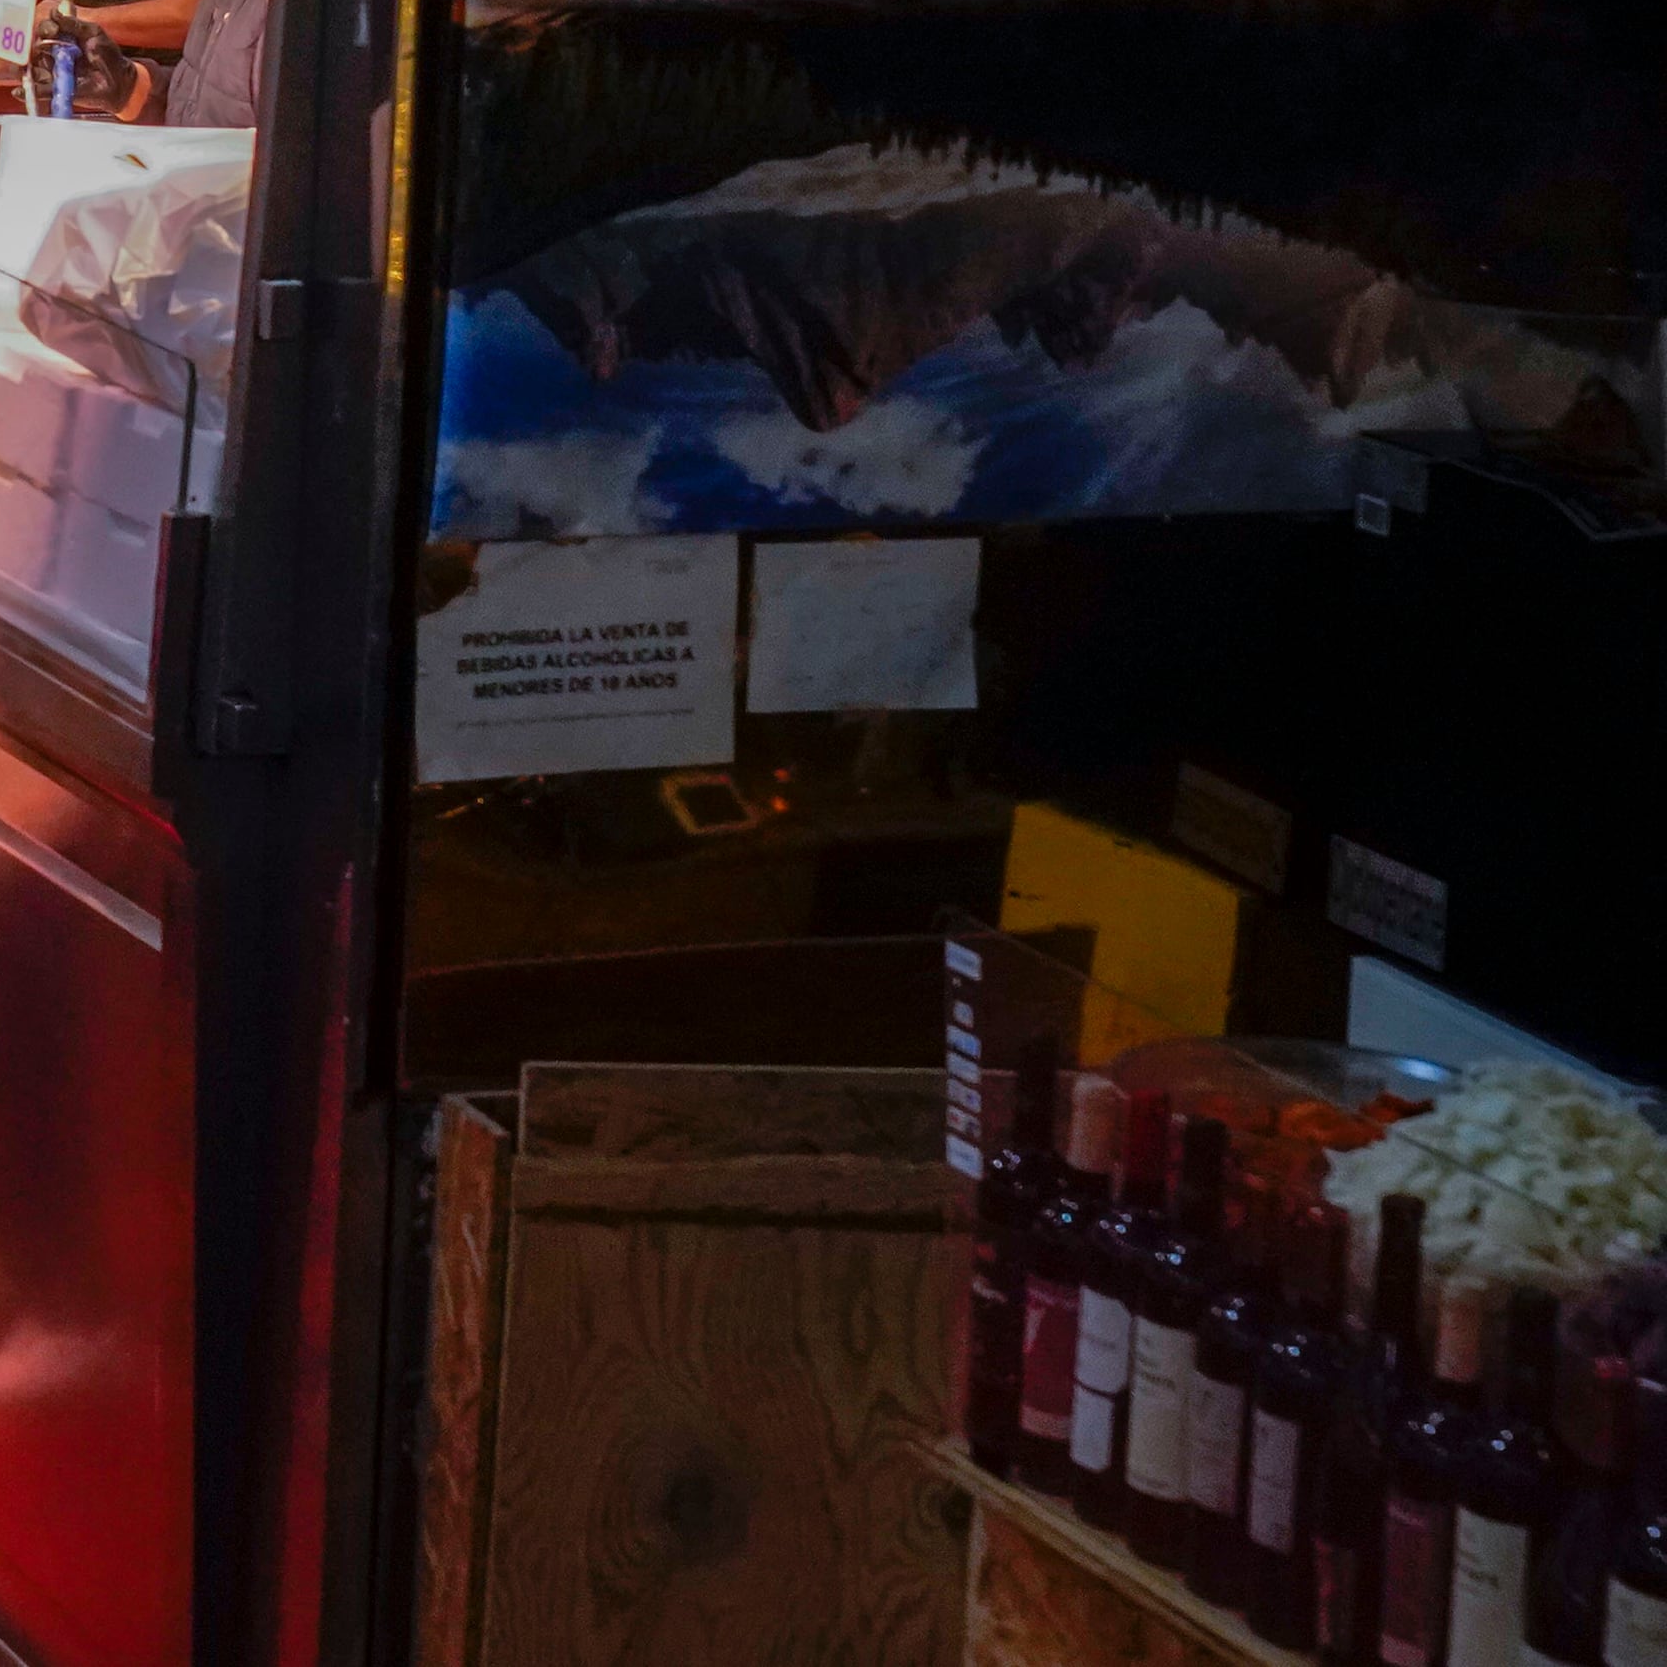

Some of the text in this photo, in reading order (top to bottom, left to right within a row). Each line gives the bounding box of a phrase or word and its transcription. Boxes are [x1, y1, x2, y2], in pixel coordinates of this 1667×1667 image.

[1, 26, 25, 55] 80
[461, 621, 689, 648] PROHIBIDA LA VENTA DE
[456, 653, 537, 674] BEBIDAS
[473, 677, 563, 698] MENORES
[568, 676, 594, 693] DE
